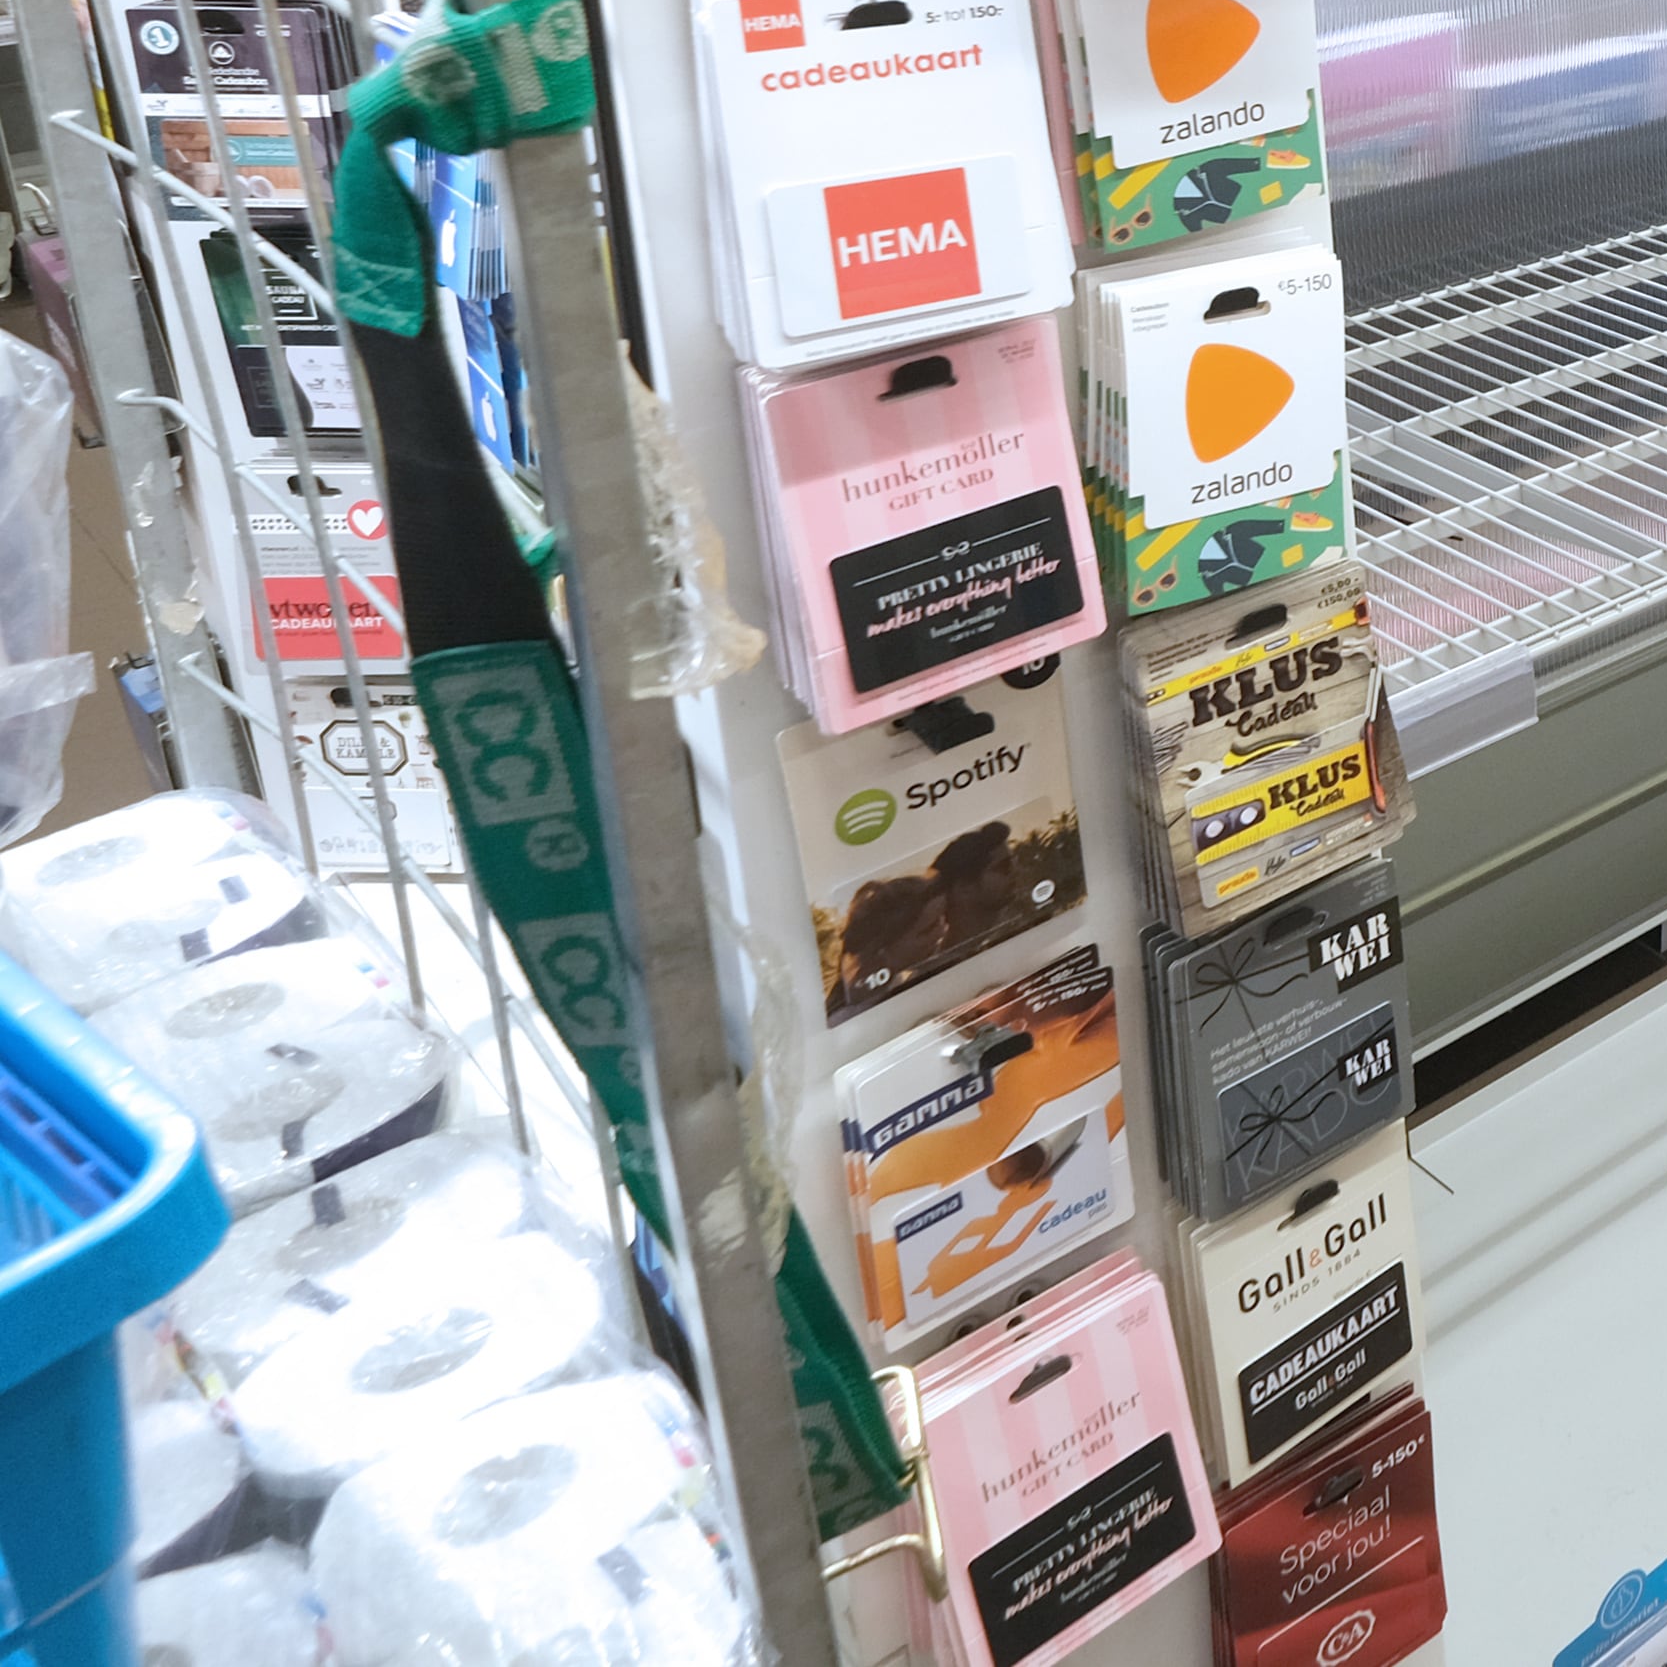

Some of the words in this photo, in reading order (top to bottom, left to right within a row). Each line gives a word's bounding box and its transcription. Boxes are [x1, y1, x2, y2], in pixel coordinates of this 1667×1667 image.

[744, 12, 802, 33] HEMA
[945, 9, 965, 23] tot
[760, 43, 984, 93] cadeaukaart
[1159, 100, 1266, 145] zalando
[837, 218, 969, 269] HEMA
[1277, 272, 1333, 296] €5-150
[840, 430, 1026, 504] hunkemöller
[887, 484, 938, 513] GIFT
[940, 468, 995, 497] CARD
[1190, 461, 1294, 505] zalando
[866, 604, 923, 639] makes
[925, 573, 1013, 620] everything
[1015, 558, 1062, 586] better
[876, 572, 950, 613] PRETTY
[954, 541, 1044, 584] LINGERIE
[269, 597, 384, 620] vtwoen
[270, 615, 384, 631] CADEAUAART
[1188, 635, 1344, 728] KLUS
[1224, 691, 1319, 738] Cadeau
[905, 744, 1026, 811] Spotify
[1268, 752, 1362, 811] KLUS
[1289, 787, 1346, 818] Cadeau
[1318, 910, 1392, 966] KAR
[1333, 933, 1393, 983] WEI
[1209, 1044, 1232, 1061] Het
[1243, 1054, 1264, 1071] van
[1344, 1037, 1392, 1078] KAR
[1353, 1055, 1394, 1088] WEI
[873, 1075, 986, 1152] GAMMA
[1038, 1188, 1108, 1234] cadeau
[1087, 1200, 1108, 1220] pas
[1272, 1275, 1321, 1315] SINDS
[1327, 1247, 1362, 1277] 1884
[1249, 1283, 1400, 1407] CADEAUKAART
[980, 1390, 1141, 1504] hunkemöller
[1020, 1464, 1064, 1499] GIFT
[1066, 1431, 1115, 1470] CARD
[1011, 1542, 1076, 1596] PRETTY
[1080, 1485, 1158, 1548] LINGERIE
[1054, 1525, 1133, 1585] everything
[1279, 1484, 1391, 1576] Speciaal
[1281, 1552, 1341, 1606] voor
[1345, 1513, 1392, 1571] jou!
